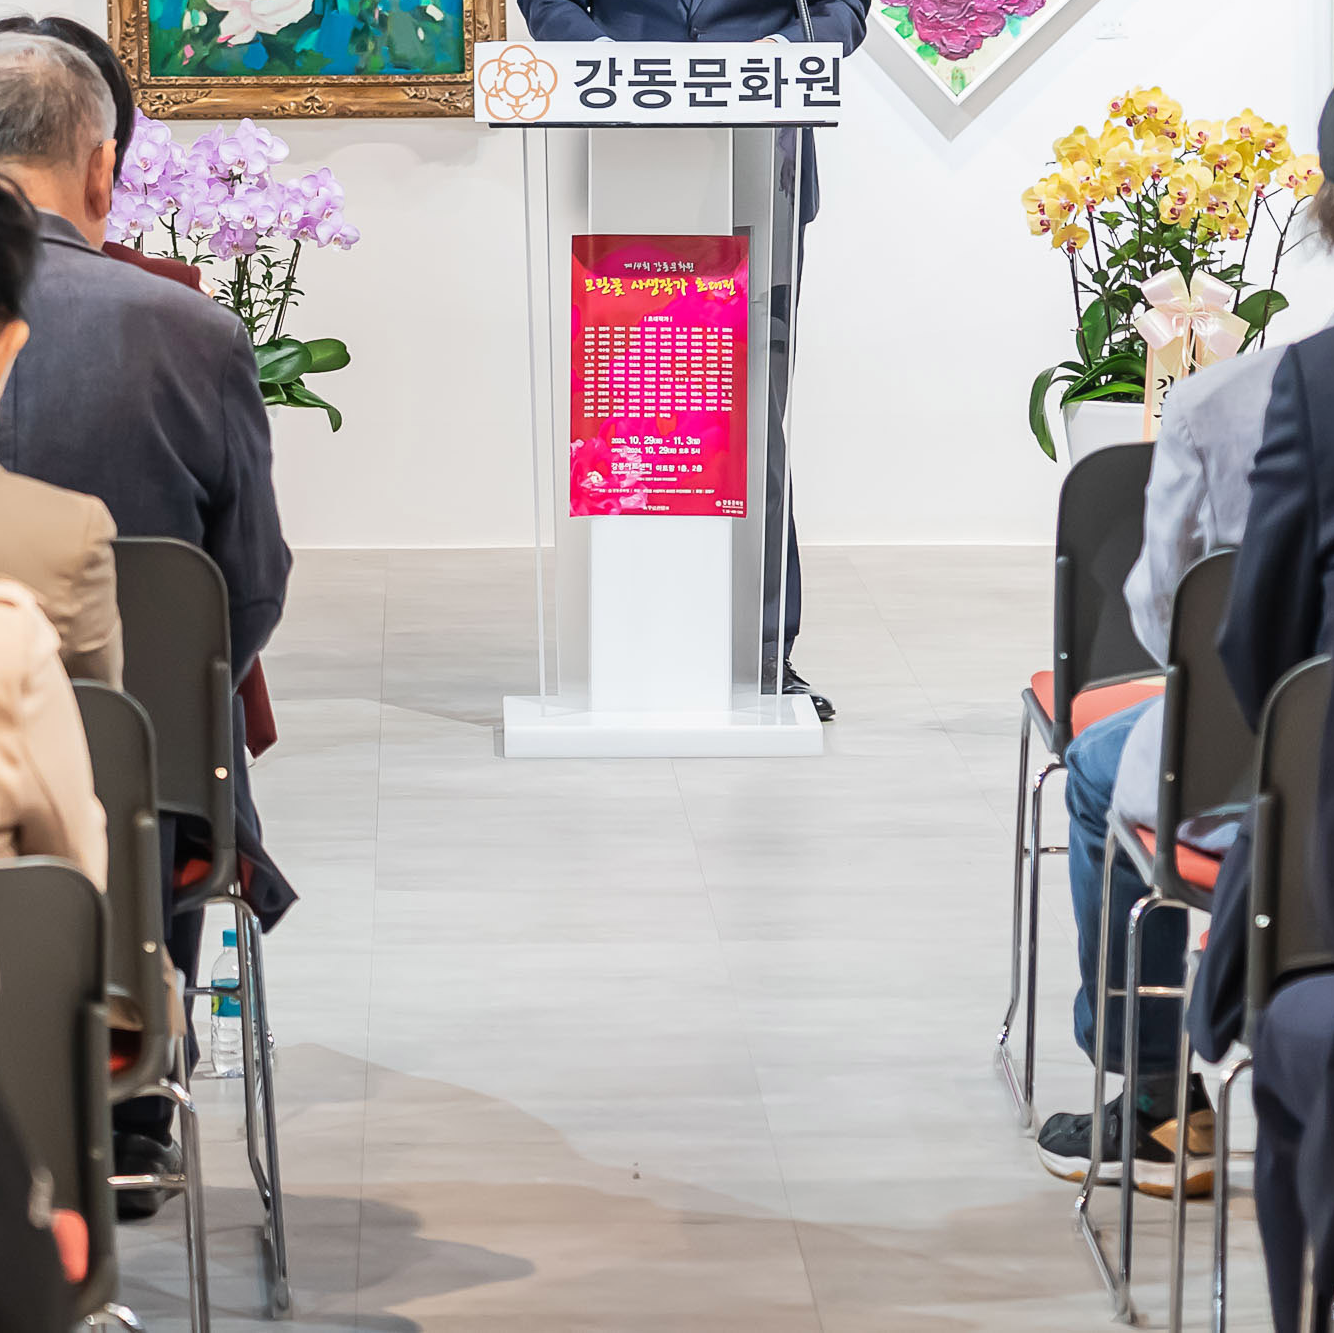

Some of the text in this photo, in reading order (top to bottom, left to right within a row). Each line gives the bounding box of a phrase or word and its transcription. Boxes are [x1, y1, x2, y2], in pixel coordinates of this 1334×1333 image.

[574, 56, 841, 108] 강동문화원
[585, 277, 737, 296] 모란꽃 사생작가 초대전
